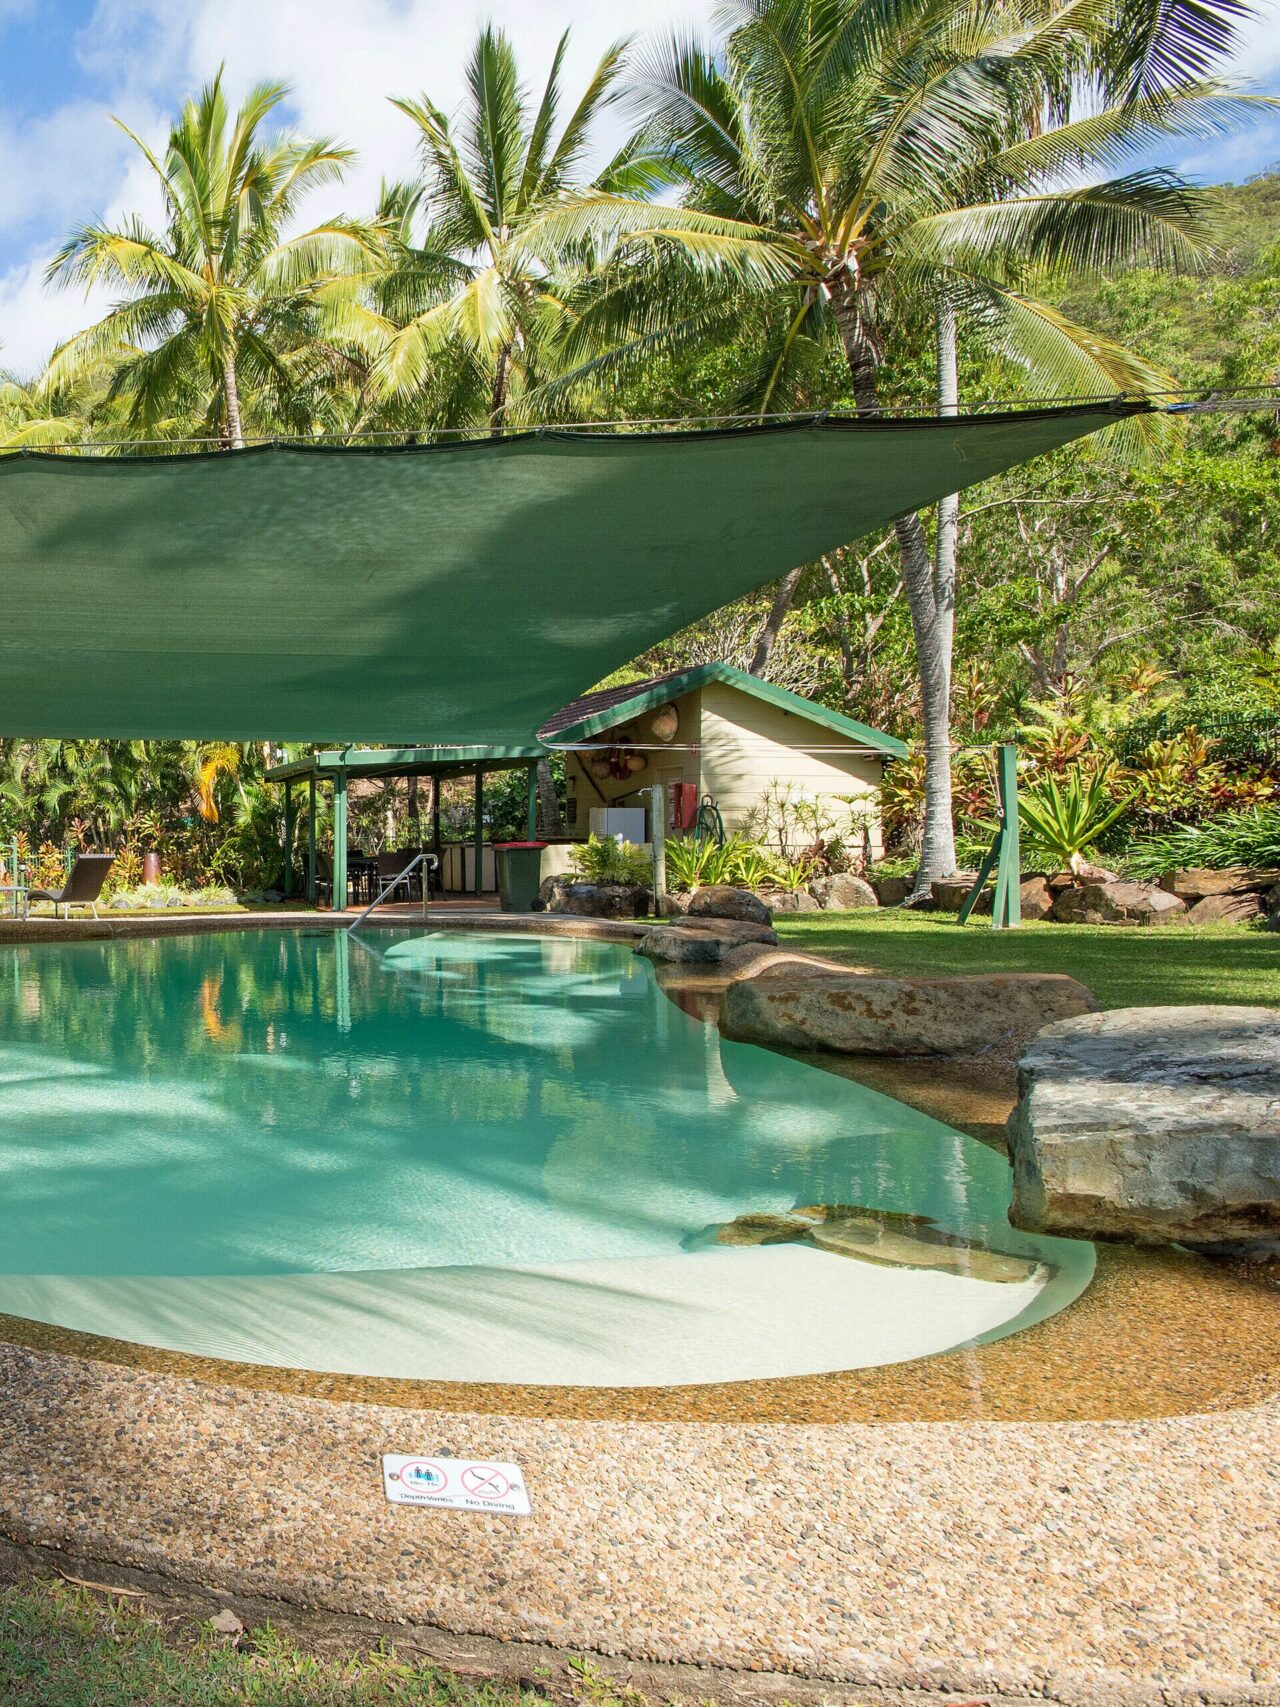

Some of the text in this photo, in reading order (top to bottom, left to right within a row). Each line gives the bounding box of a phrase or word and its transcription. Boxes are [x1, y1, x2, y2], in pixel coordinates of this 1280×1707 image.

[400, 1493, 454, 1503] Depth Varies
[465, 1498, 515, 1510] No Diving
